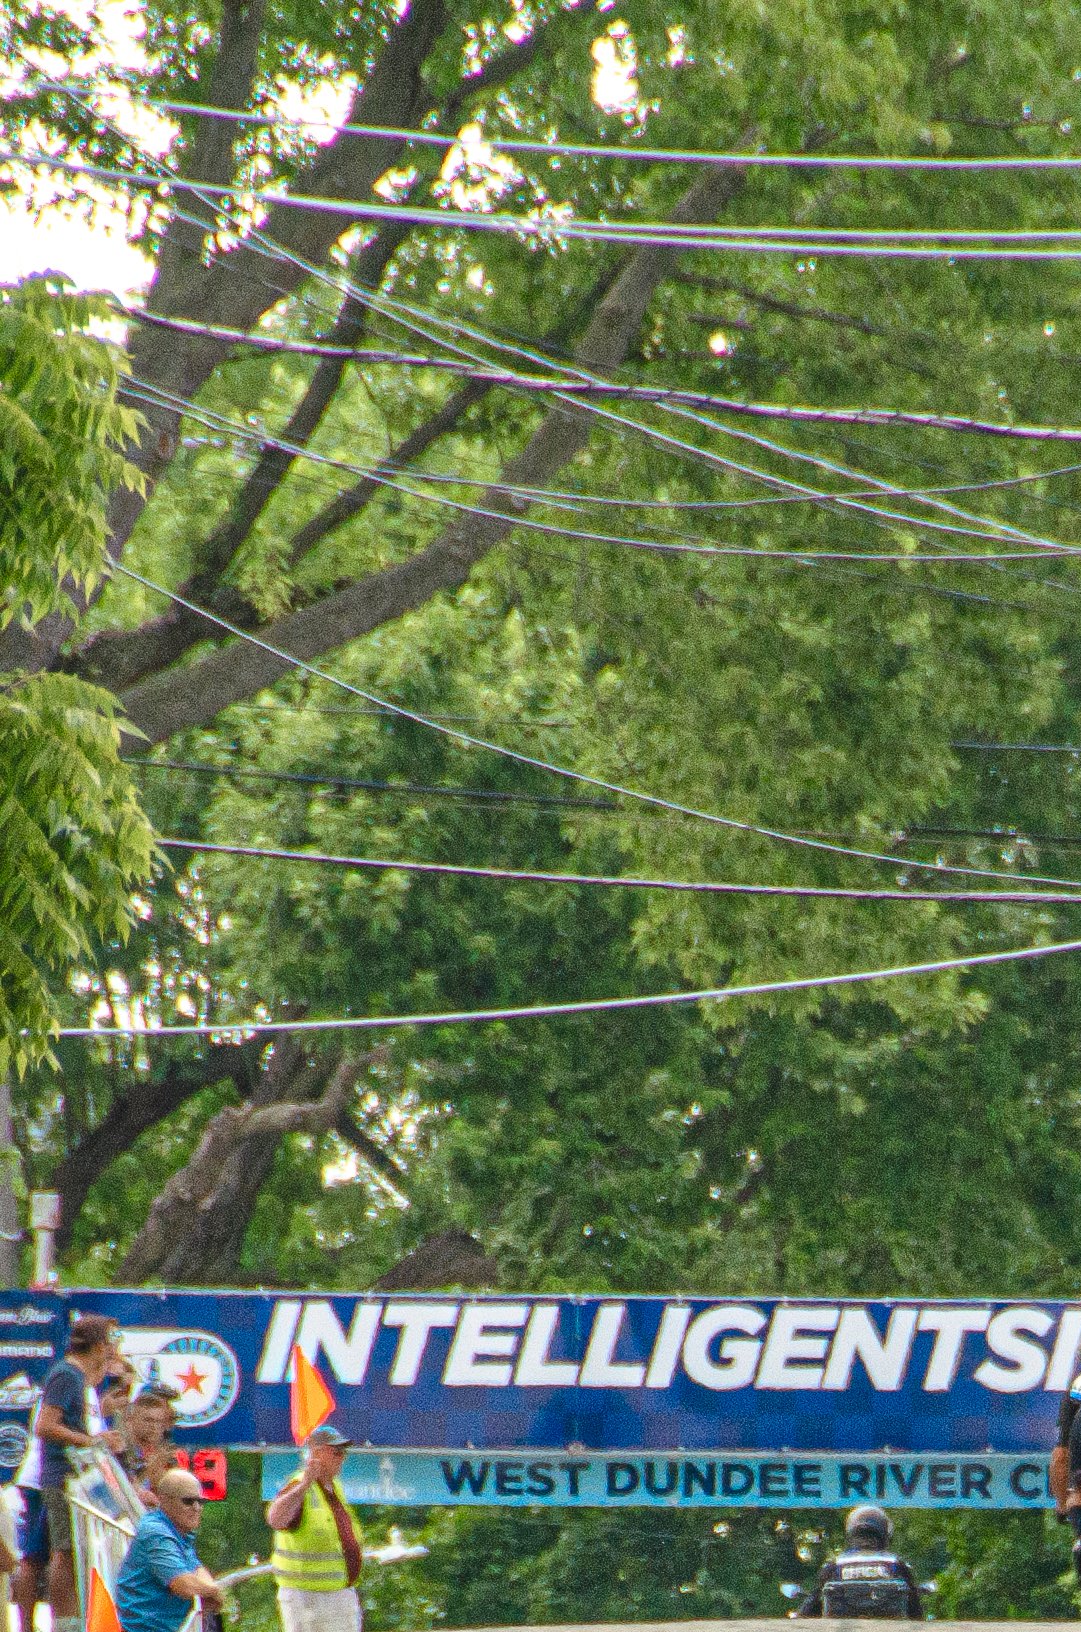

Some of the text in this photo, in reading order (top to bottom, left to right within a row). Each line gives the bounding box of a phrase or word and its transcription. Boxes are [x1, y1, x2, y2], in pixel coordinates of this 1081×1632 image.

[441, 1461, 591, 1497] WEST
[606, 1461, 823, 1498] DUNDEE
[840, 1463, 992, 1500] RIVER
